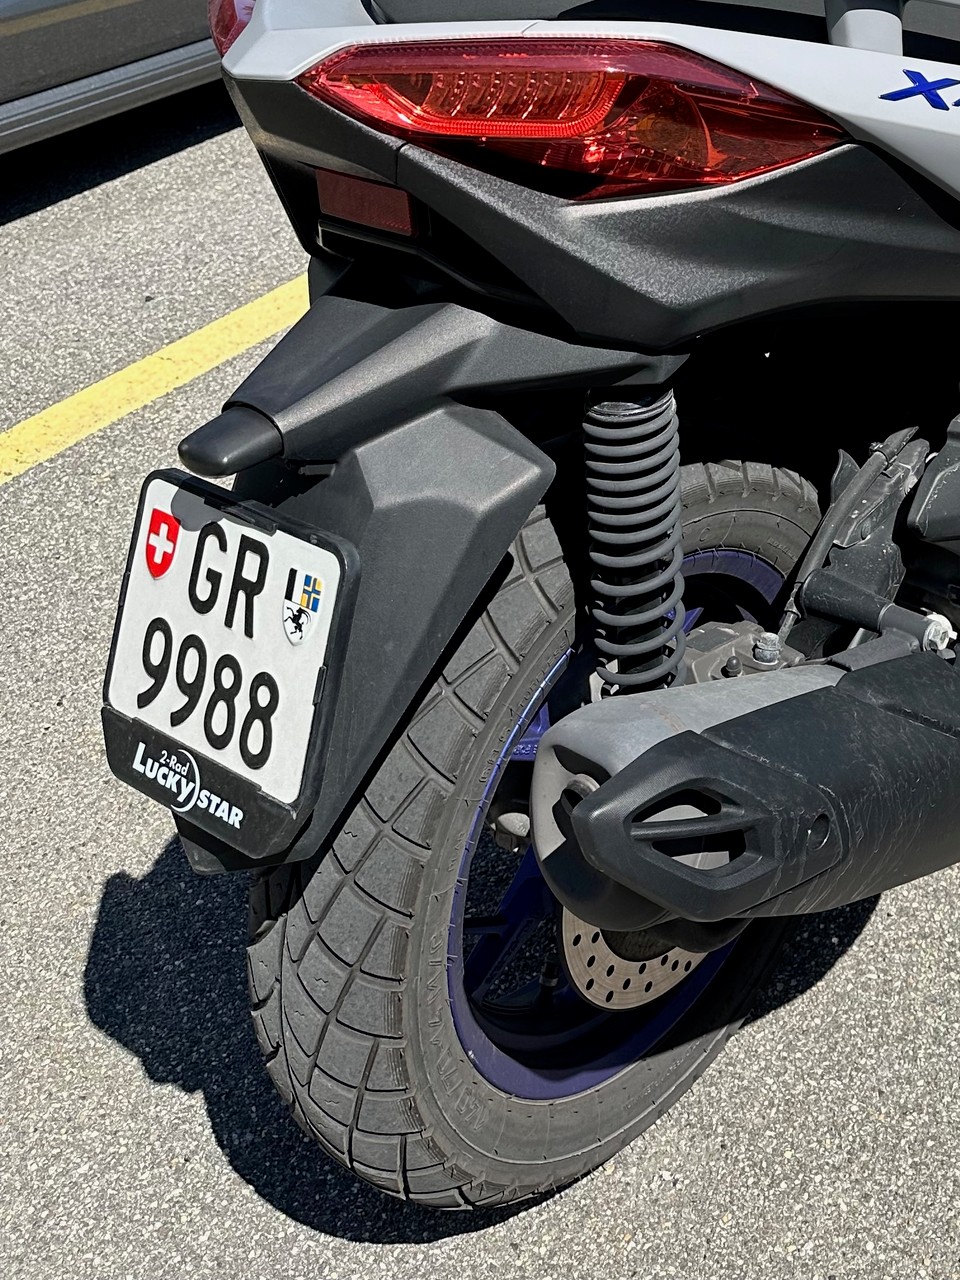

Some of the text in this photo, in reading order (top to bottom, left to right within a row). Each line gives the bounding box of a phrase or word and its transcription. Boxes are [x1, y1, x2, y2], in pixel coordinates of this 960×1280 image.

[187, 521, 270, 640] GR
[136, 616, 280, 770] 9988
[160, 749, 190, 776] 2-Rad
[196, 789, 244, 829] STAR
